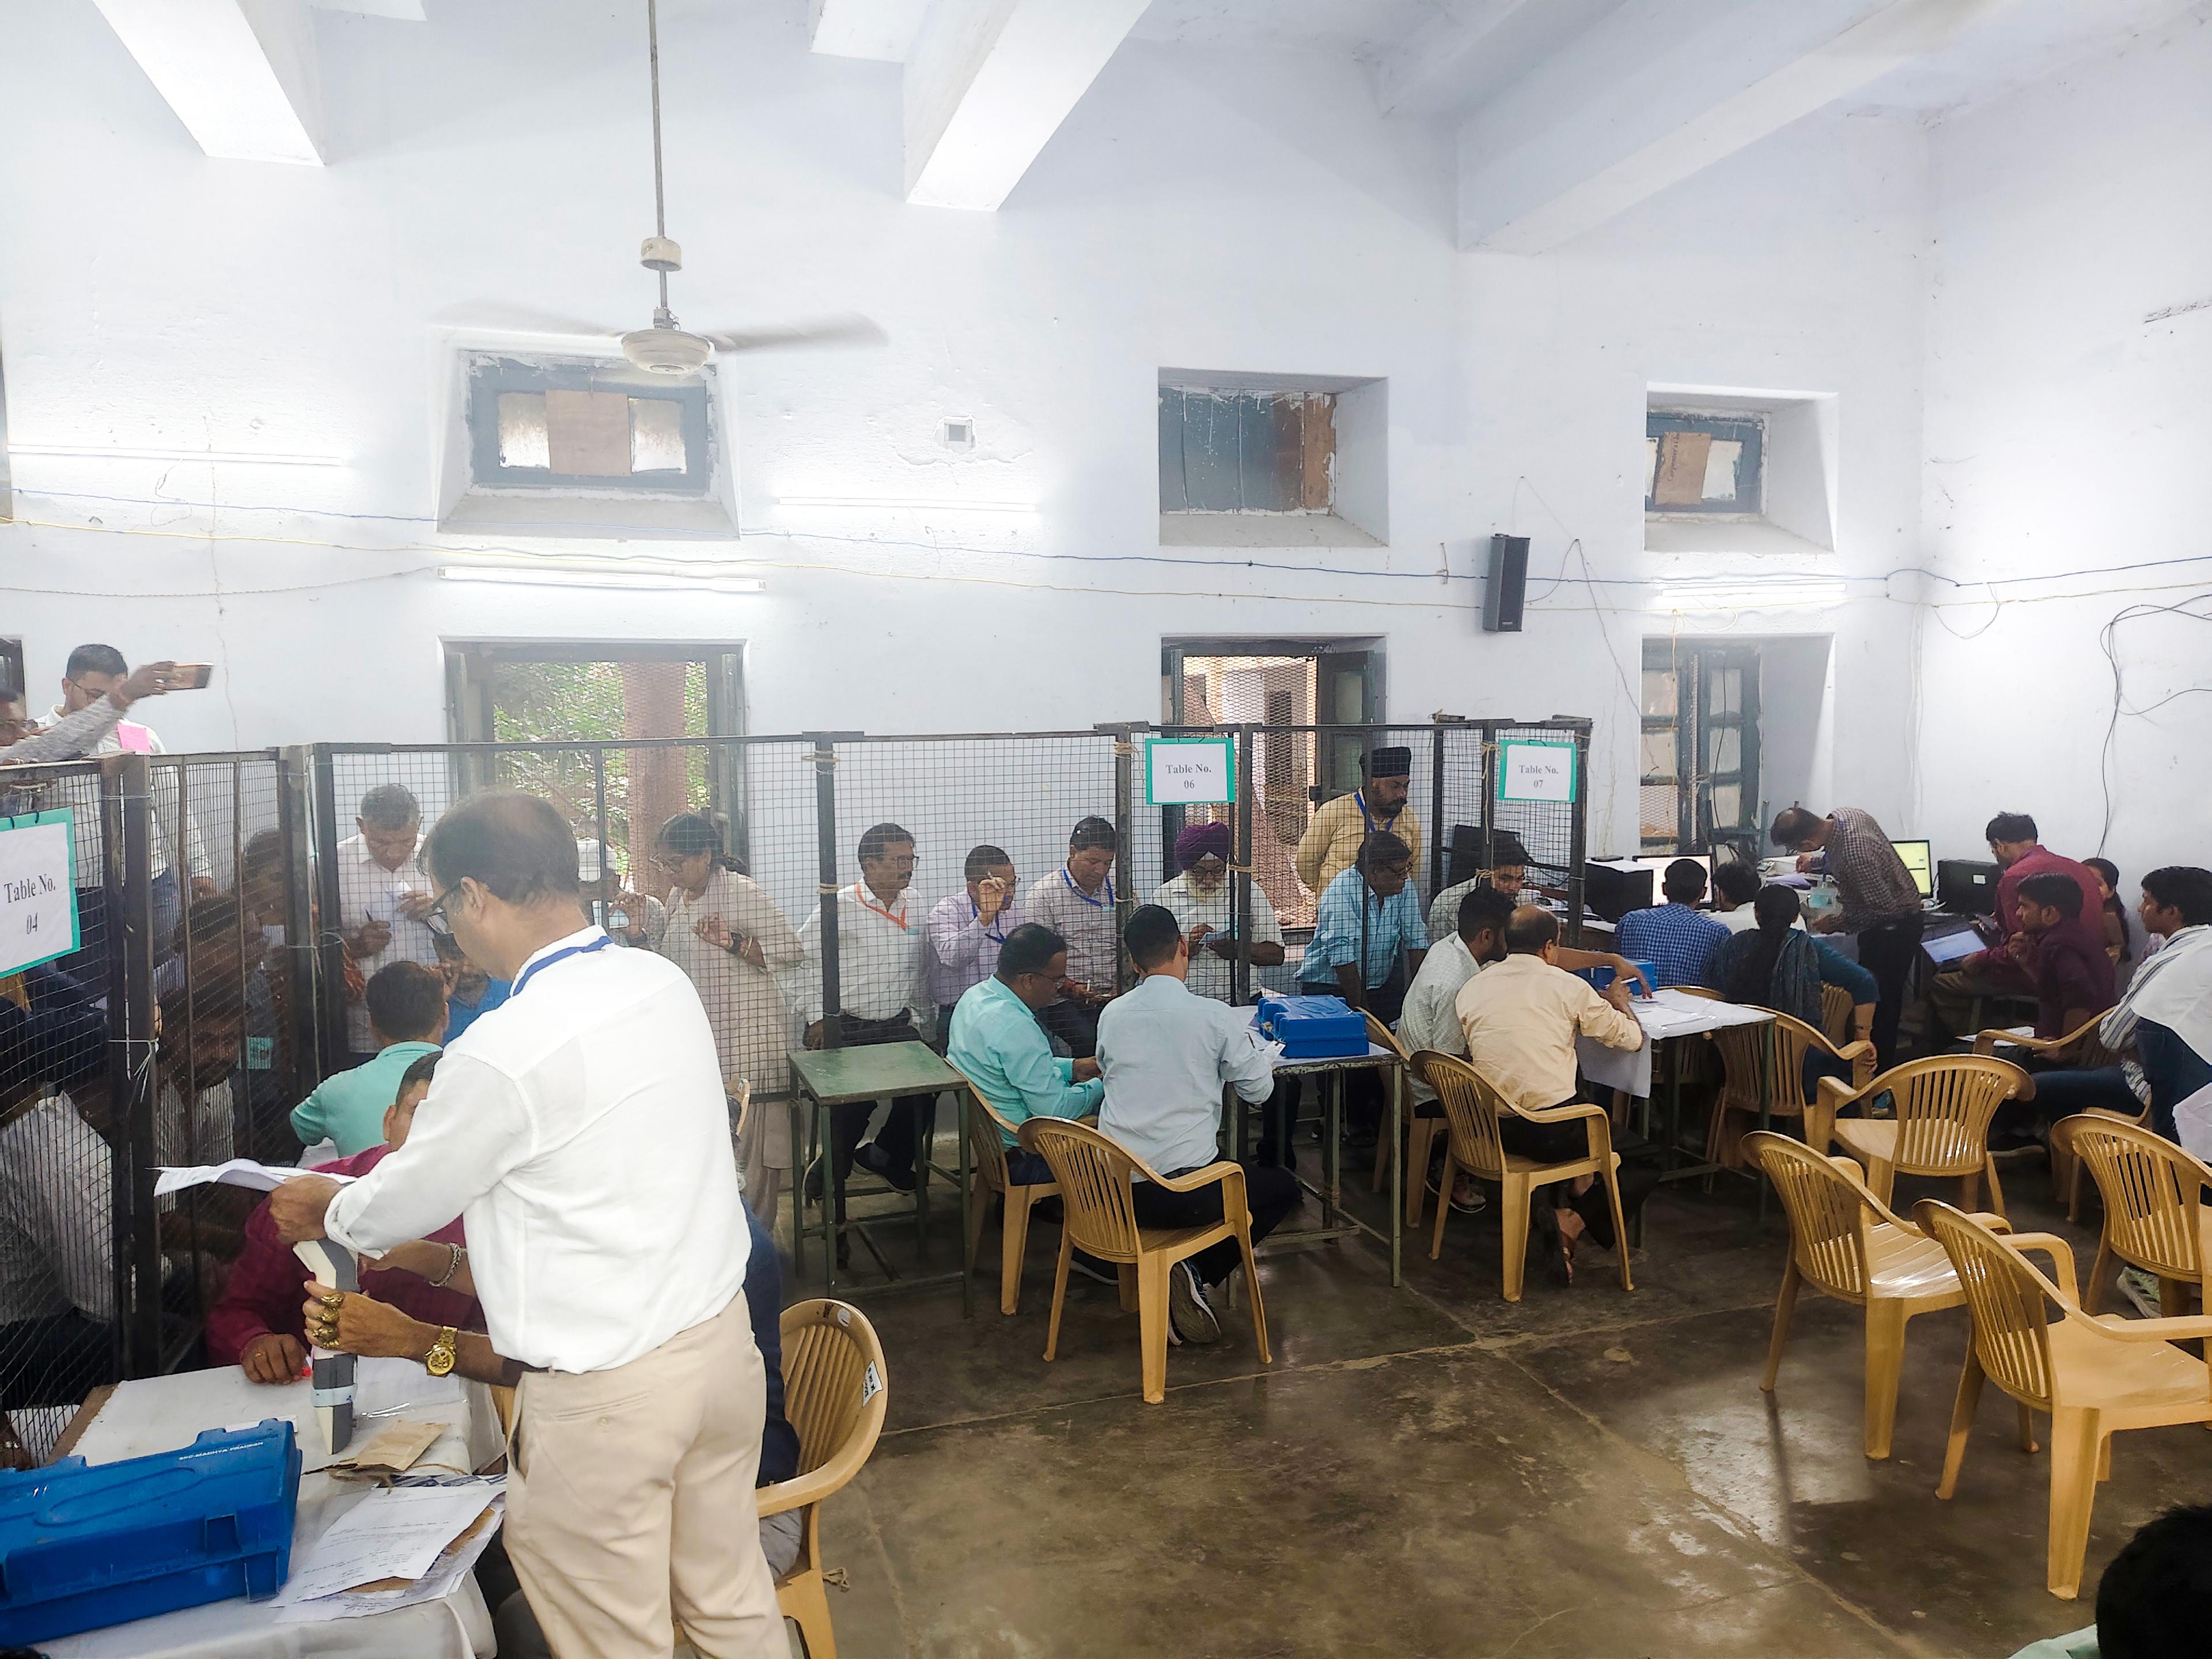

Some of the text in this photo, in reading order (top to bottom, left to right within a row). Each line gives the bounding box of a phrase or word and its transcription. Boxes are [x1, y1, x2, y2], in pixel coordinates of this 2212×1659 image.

[1165, 764, 1211, 774] Table No.
[1518, 765, 1559, 774] Table No.
[1184, 779, 1195, 789] 06
[1533, 779, 1544, 788] 07
[4, 874, 56, 904] Table No.
[26, 912, 38, 935] 04
